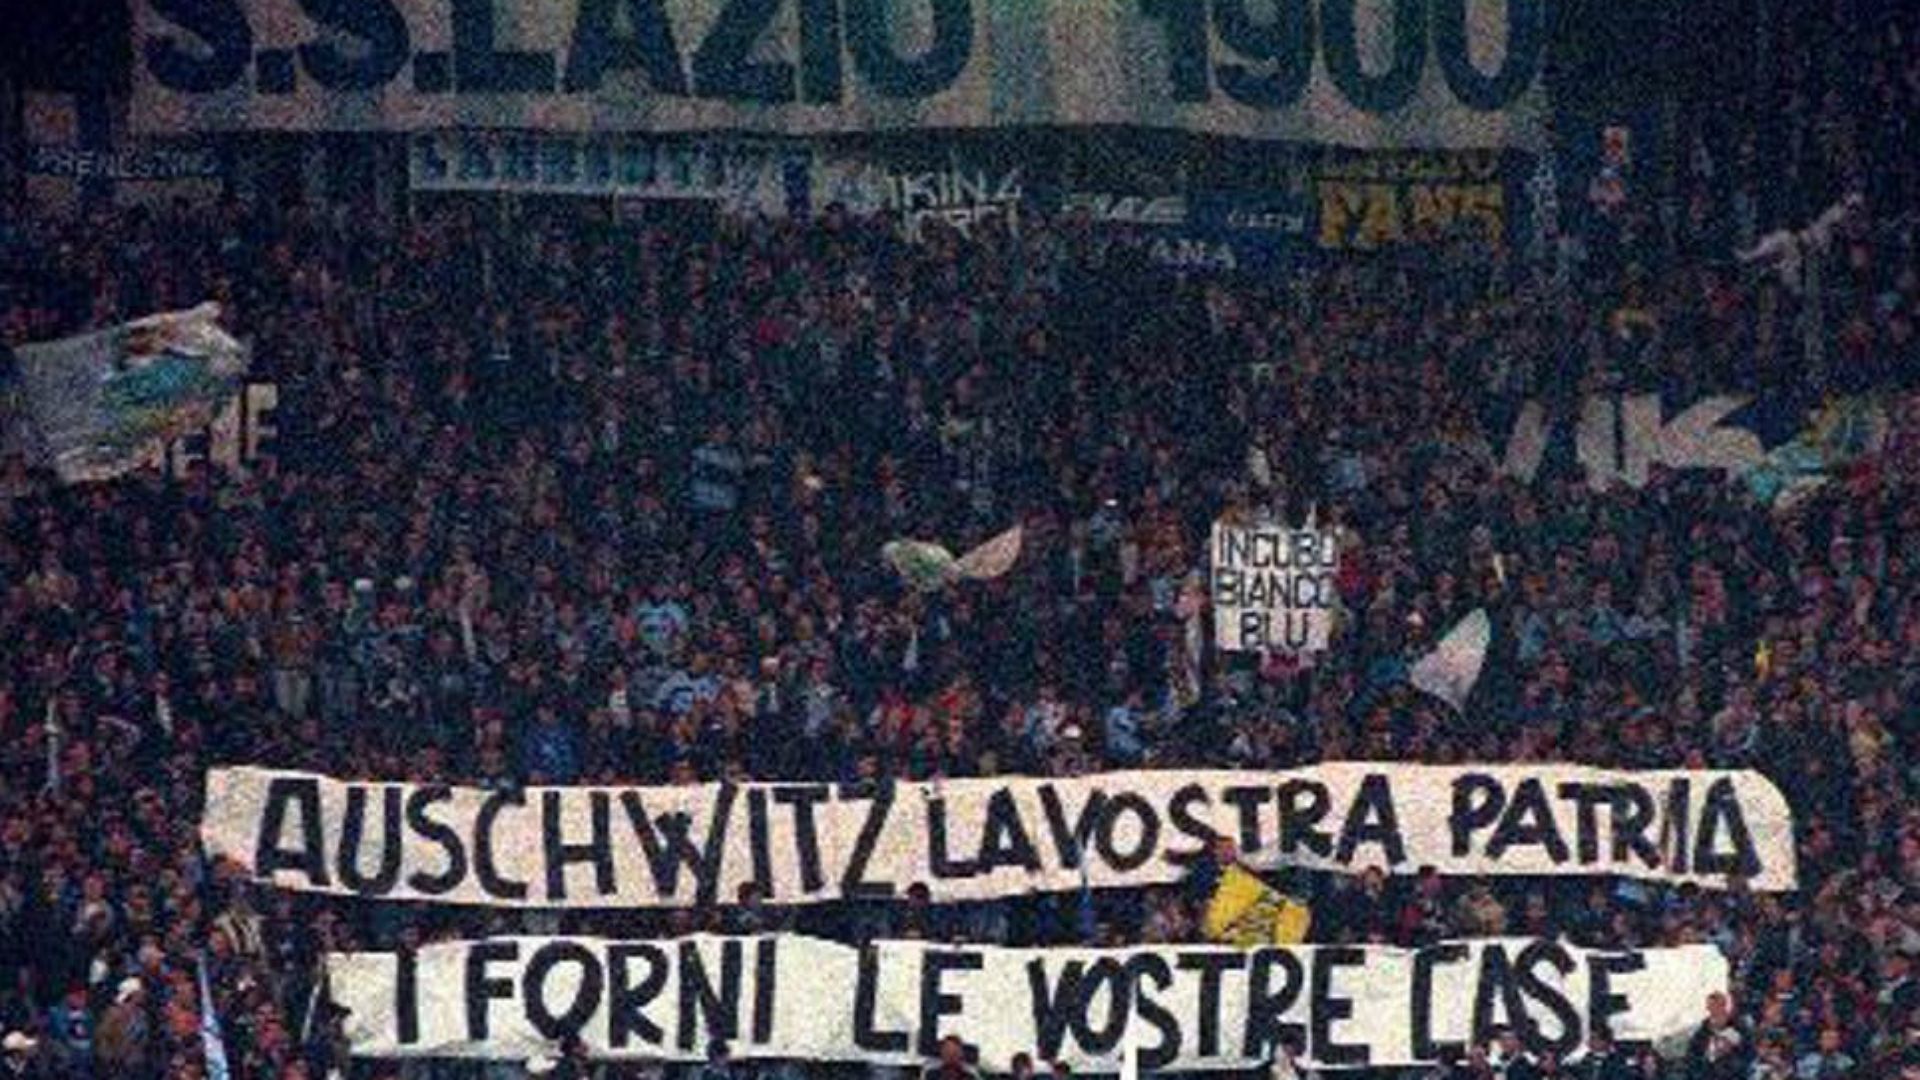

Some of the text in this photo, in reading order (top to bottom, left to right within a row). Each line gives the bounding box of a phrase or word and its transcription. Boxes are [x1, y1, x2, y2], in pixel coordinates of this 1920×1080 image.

[1137, 0, 1546, 111] 1900
[1219, 530, 1338, 568] INCUBO
[1215, 568, 1337, 609] BIANCO
[1240, 611, 1310, 651] BLU
[255, 775, 897, 905] AUSCHWITZ
[1448, 773, 1762, 877] PATRIA
[396, 938, 1654, 1070] I FORNI LE VOSTRE CASE
